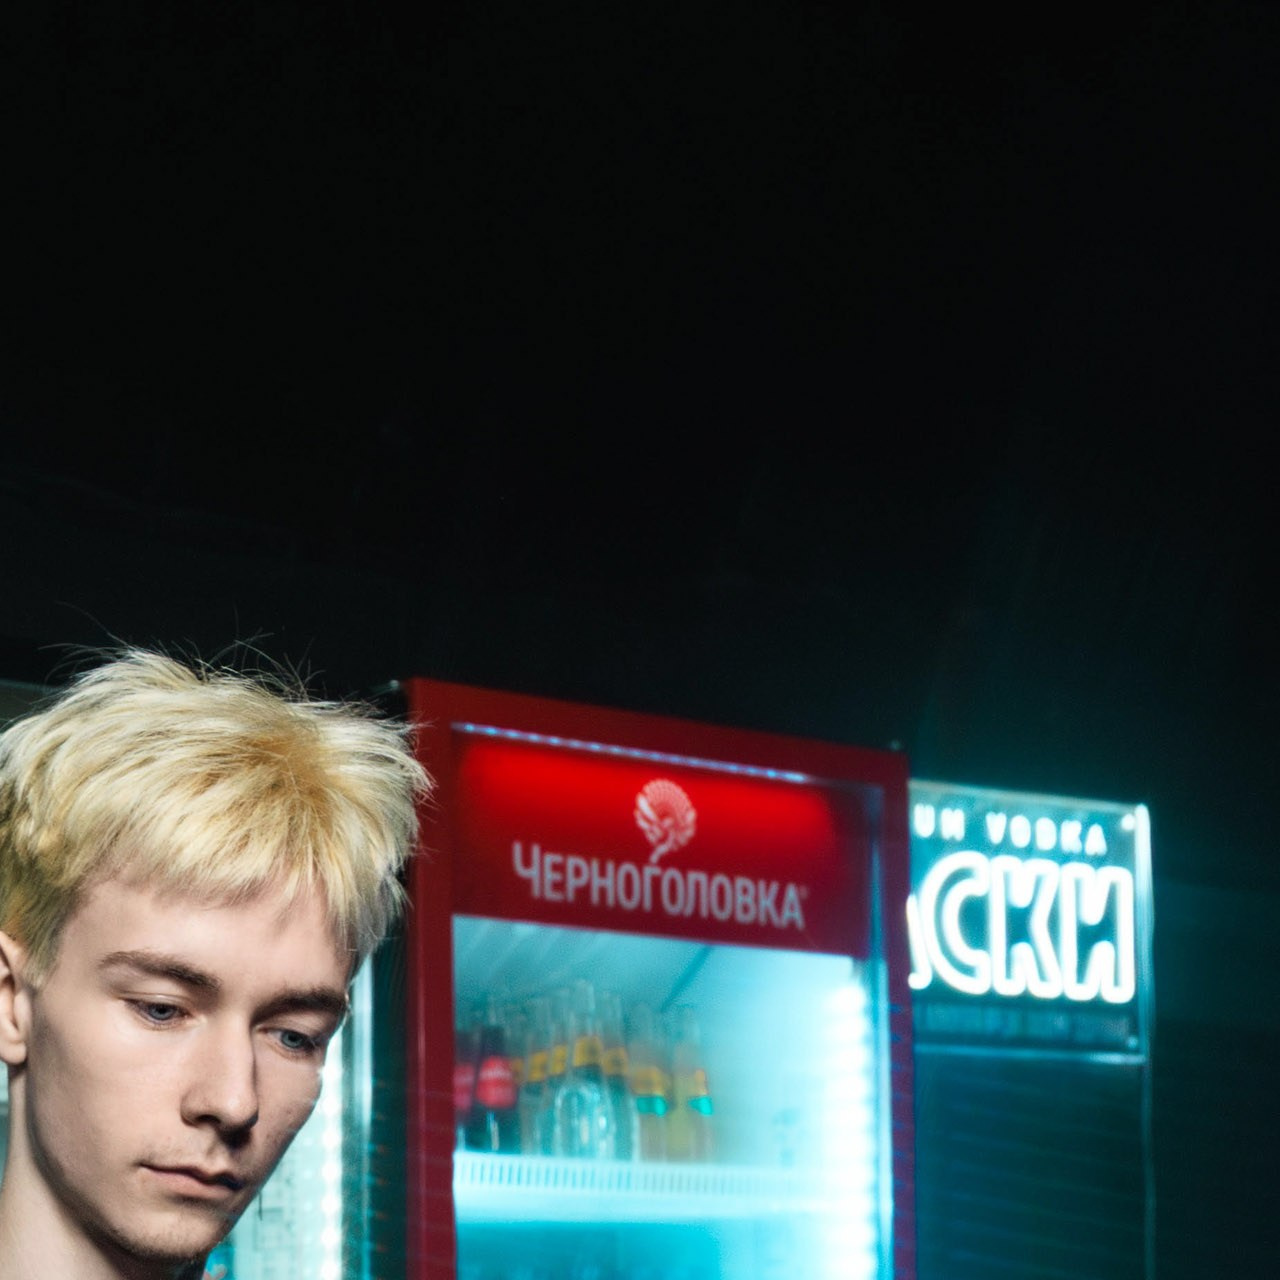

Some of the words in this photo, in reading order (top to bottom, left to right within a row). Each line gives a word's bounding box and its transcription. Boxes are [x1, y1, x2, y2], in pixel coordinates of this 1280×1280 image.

[985, 811, 1108, 856] VODKA
[511, 841, 806, 931] ЧЕРНОГОЛОВКА
[906, 850, 1137, 1004] СКИ
